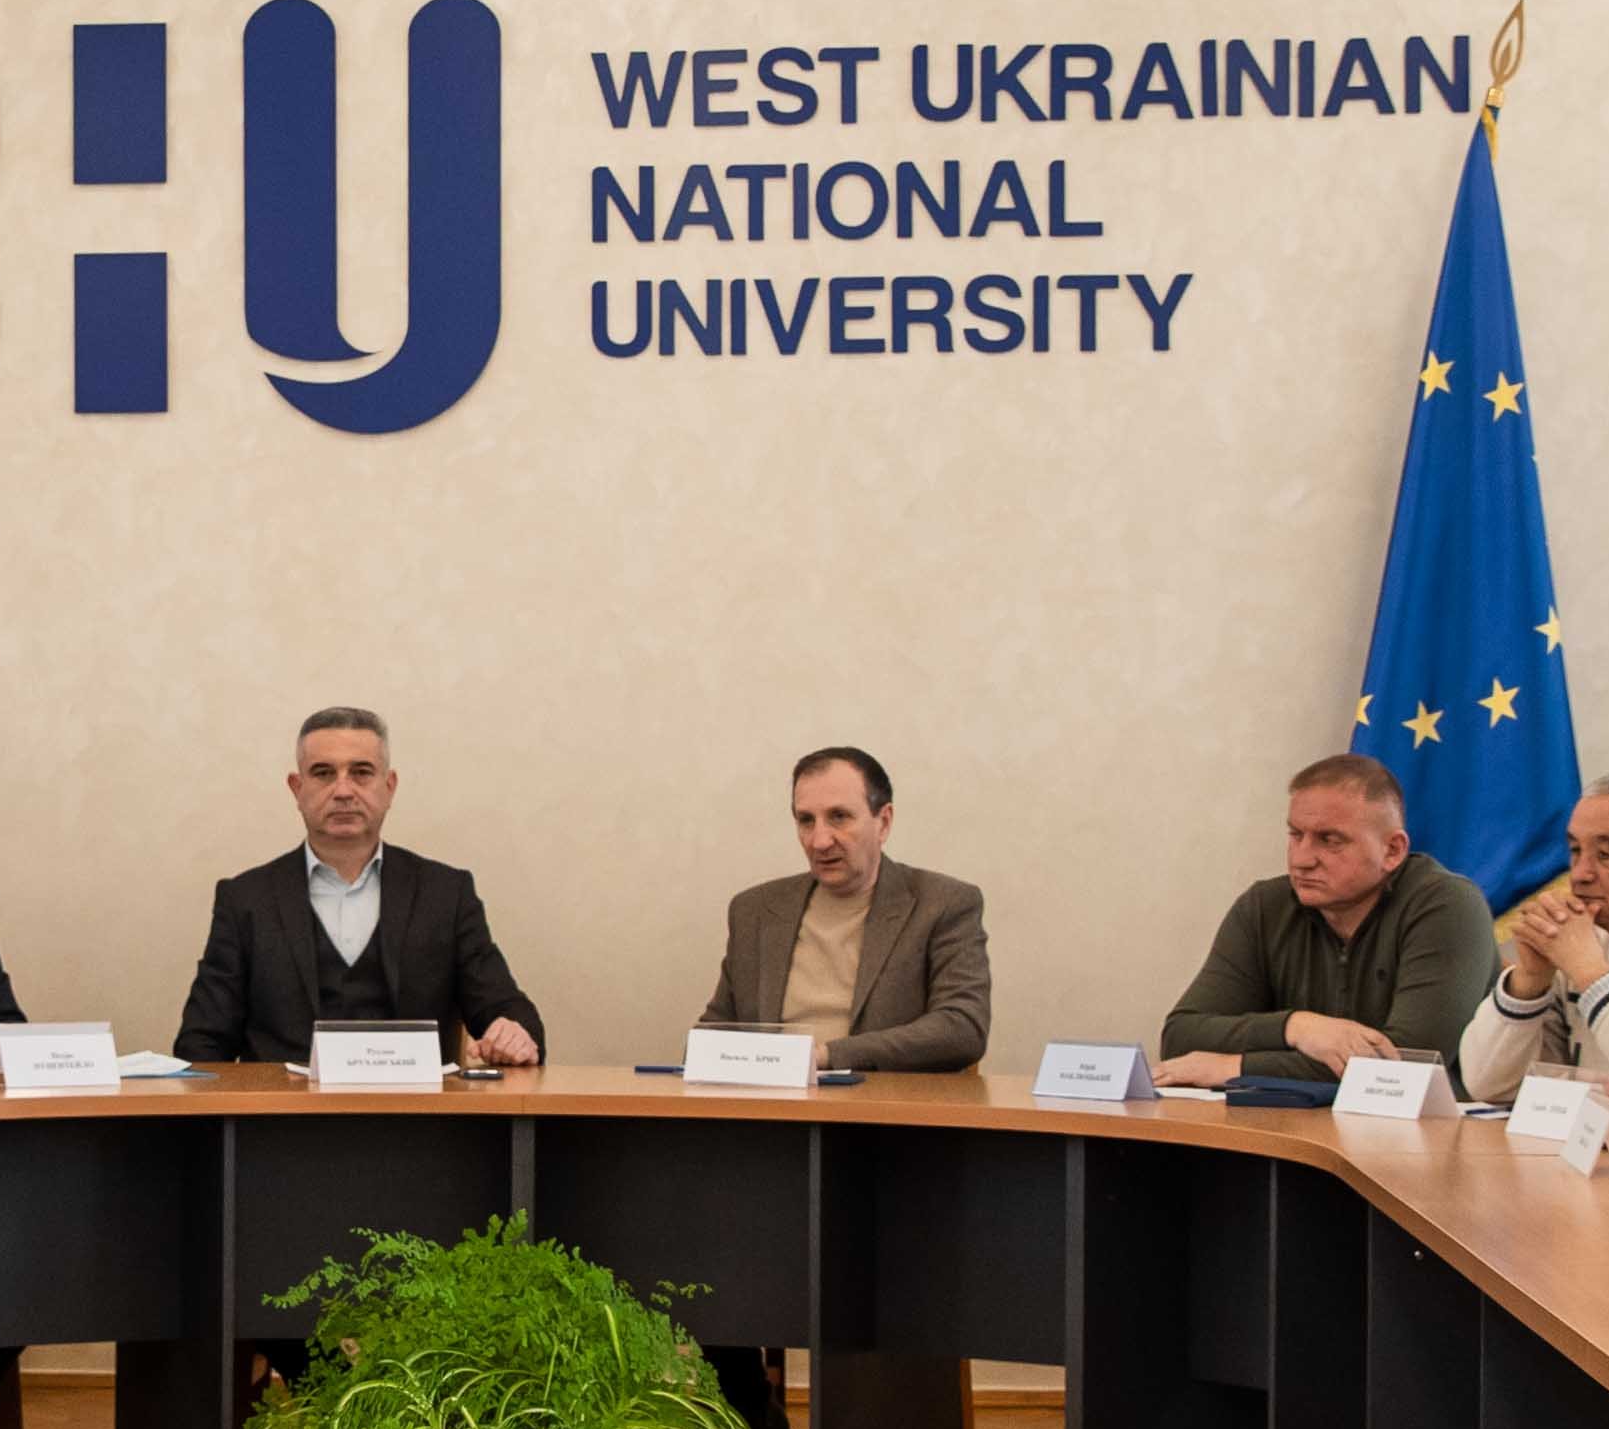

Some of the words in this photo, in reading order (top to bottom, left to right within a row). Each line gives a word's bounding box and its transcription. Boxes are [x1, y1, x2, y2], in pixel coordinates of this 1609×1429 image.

[592, 46, 880, 127] WEST
[912, 34, 1471, 124] UKRAINIAN
[591, 160, 1103, 242] NATIONAL
[591, 273, 1192, 358] UNIVERSITY
